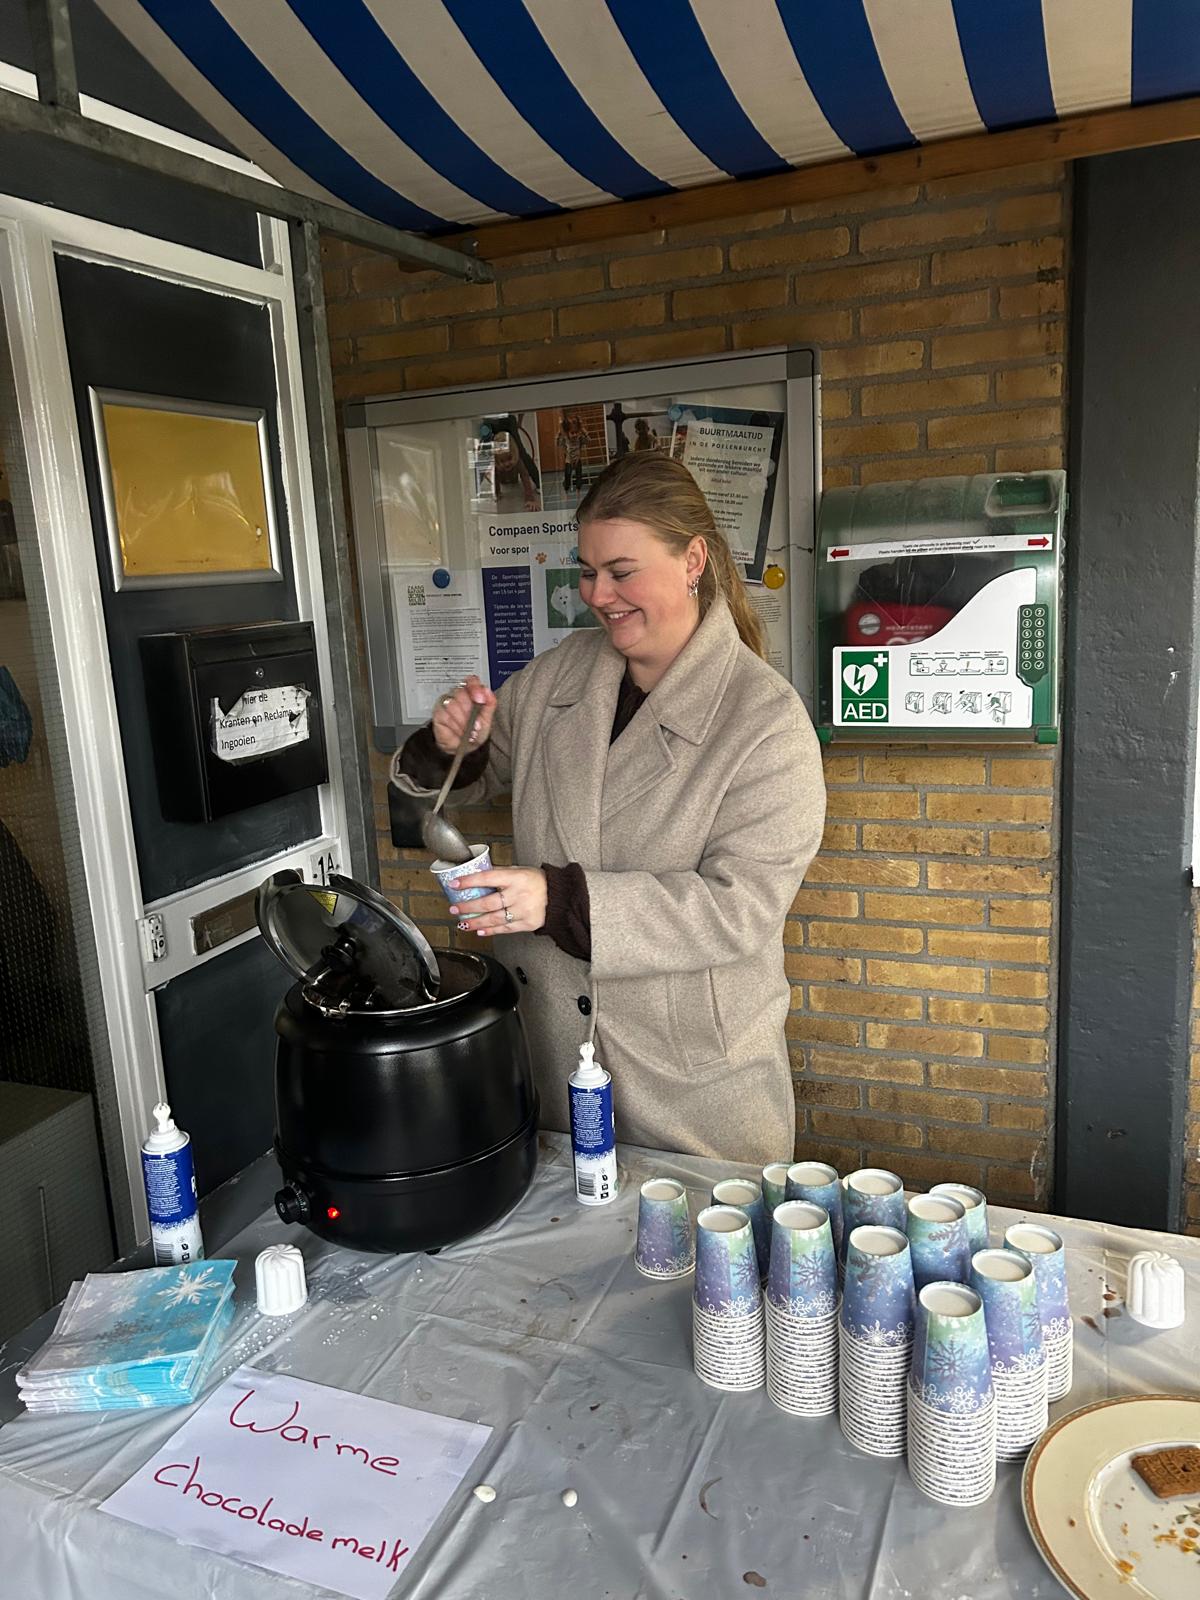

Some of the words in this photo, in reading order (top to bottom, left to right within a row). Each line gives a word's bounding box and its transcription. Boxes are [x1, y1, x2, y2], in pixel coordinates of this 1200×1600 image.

[489, 526, 540, 538] Compaen
[490, 546, 509, 555] Voor
[259, 692, 268, 702] de
[843, 702, 887, 719] AED
[220, 716, 250, 729] Kranten
[252, 714, 262, 724] en
[221, 736, 256, 750] Ingooien
[228, 1389, 400, 1476] Warme
